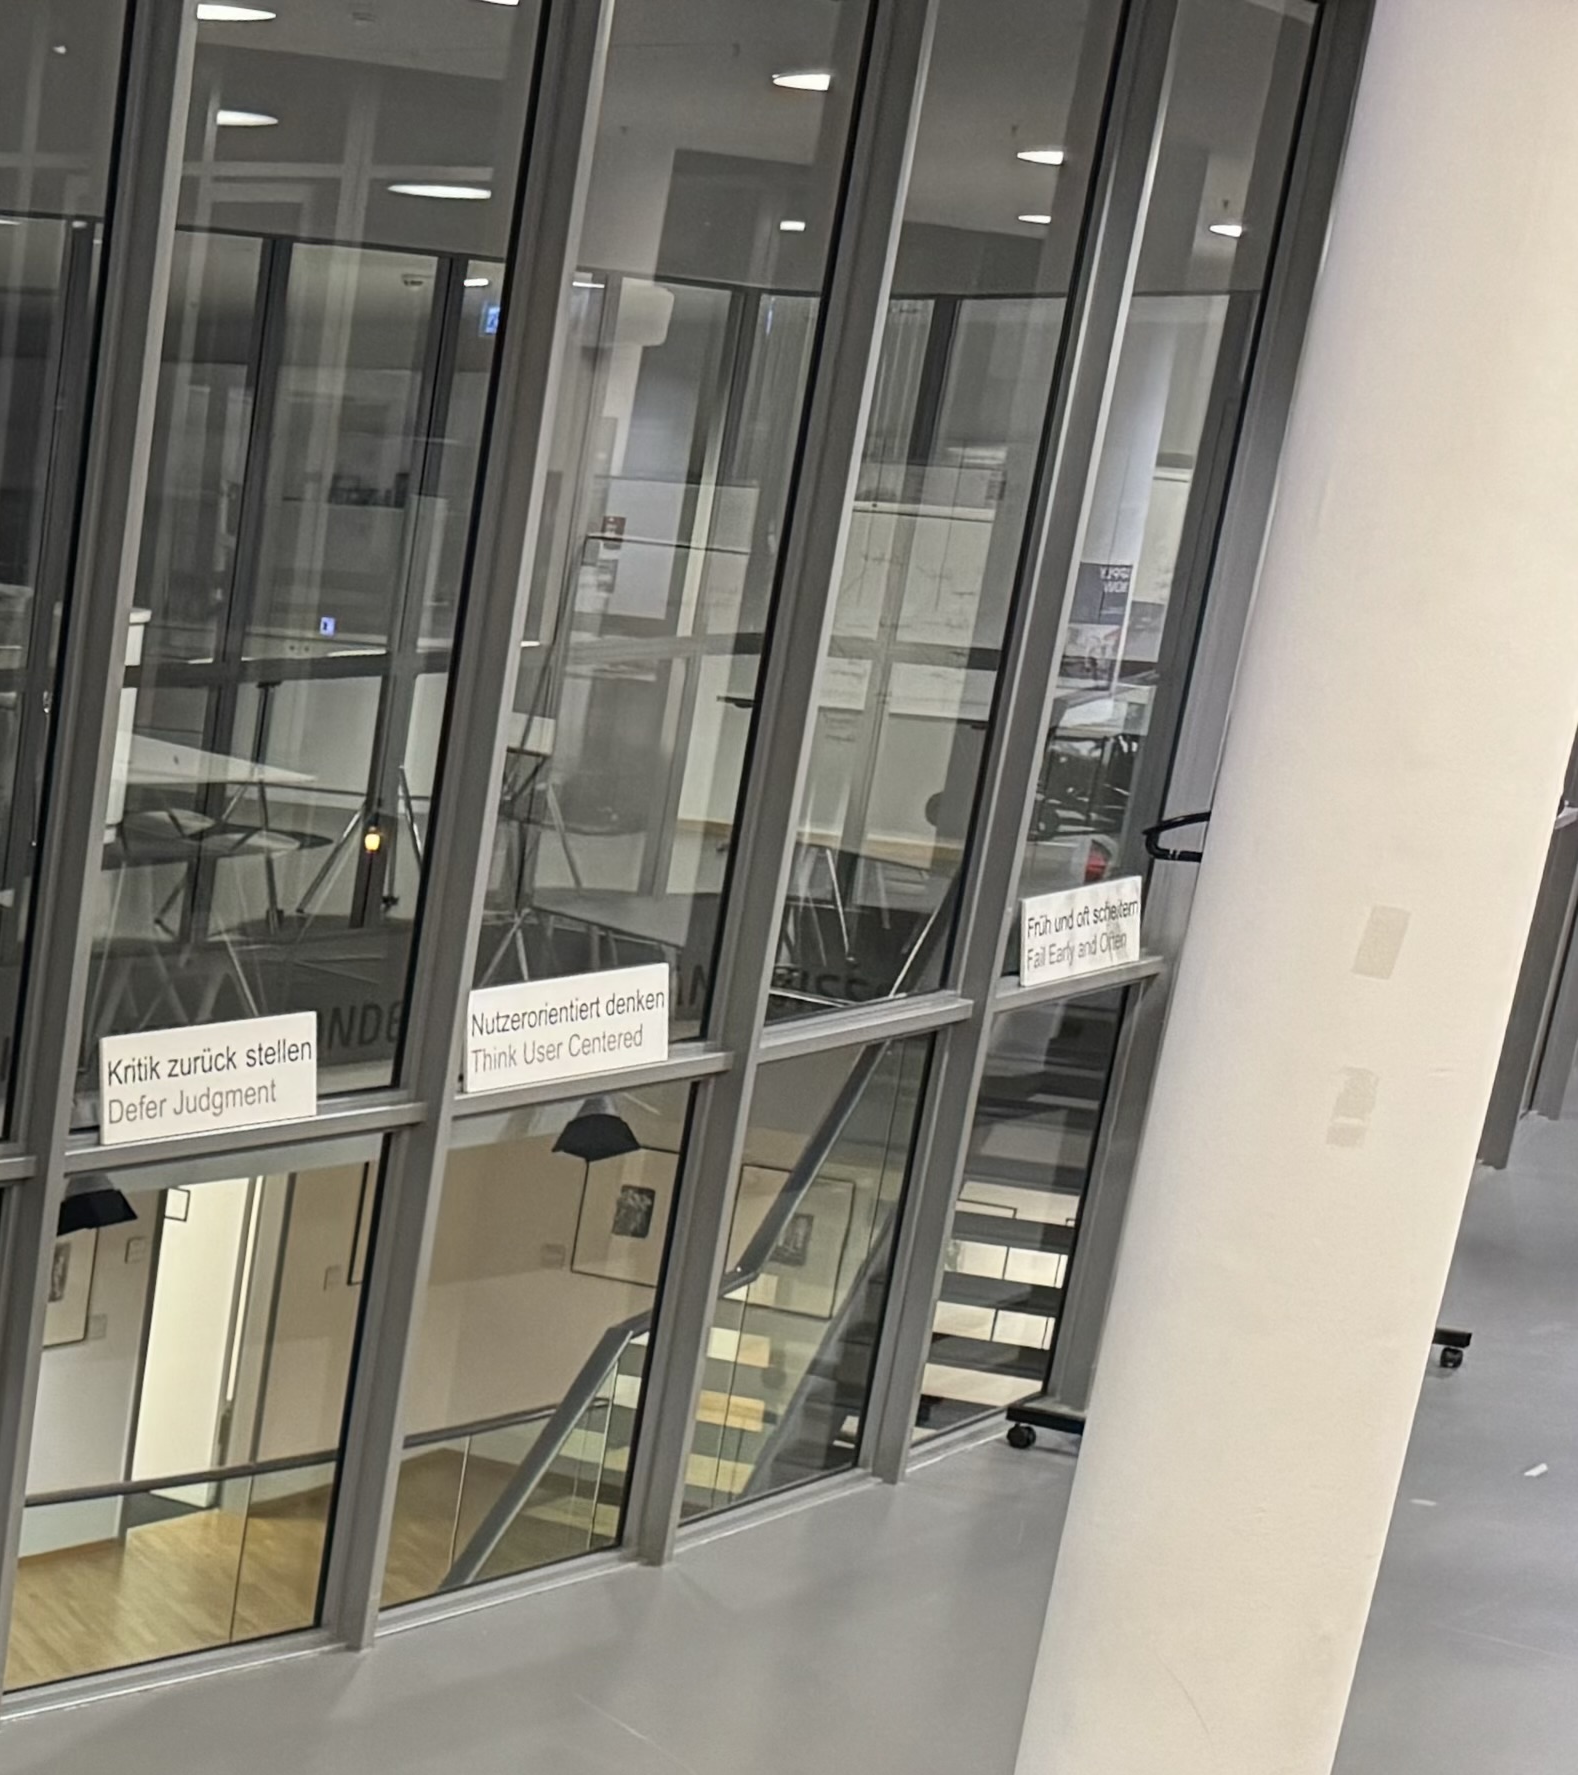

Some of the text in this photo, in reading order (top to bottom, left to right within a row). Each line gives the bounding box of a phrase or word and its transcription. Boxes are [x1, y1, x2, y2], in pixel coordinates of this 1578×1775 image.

[1054, 909, 1074, 933] und
[1076, 905, 1090, 927] oft
[1078, 934, 1097, 959] and
[471, 990, 665, 1037] Nutzerorientiert denken
[108, 1039, 312, 1086] Kritik zurück stellen
[471, 1024, 643, 1073] Think User Centered
[108, 1079, 276, 1124] Defer Judgment
